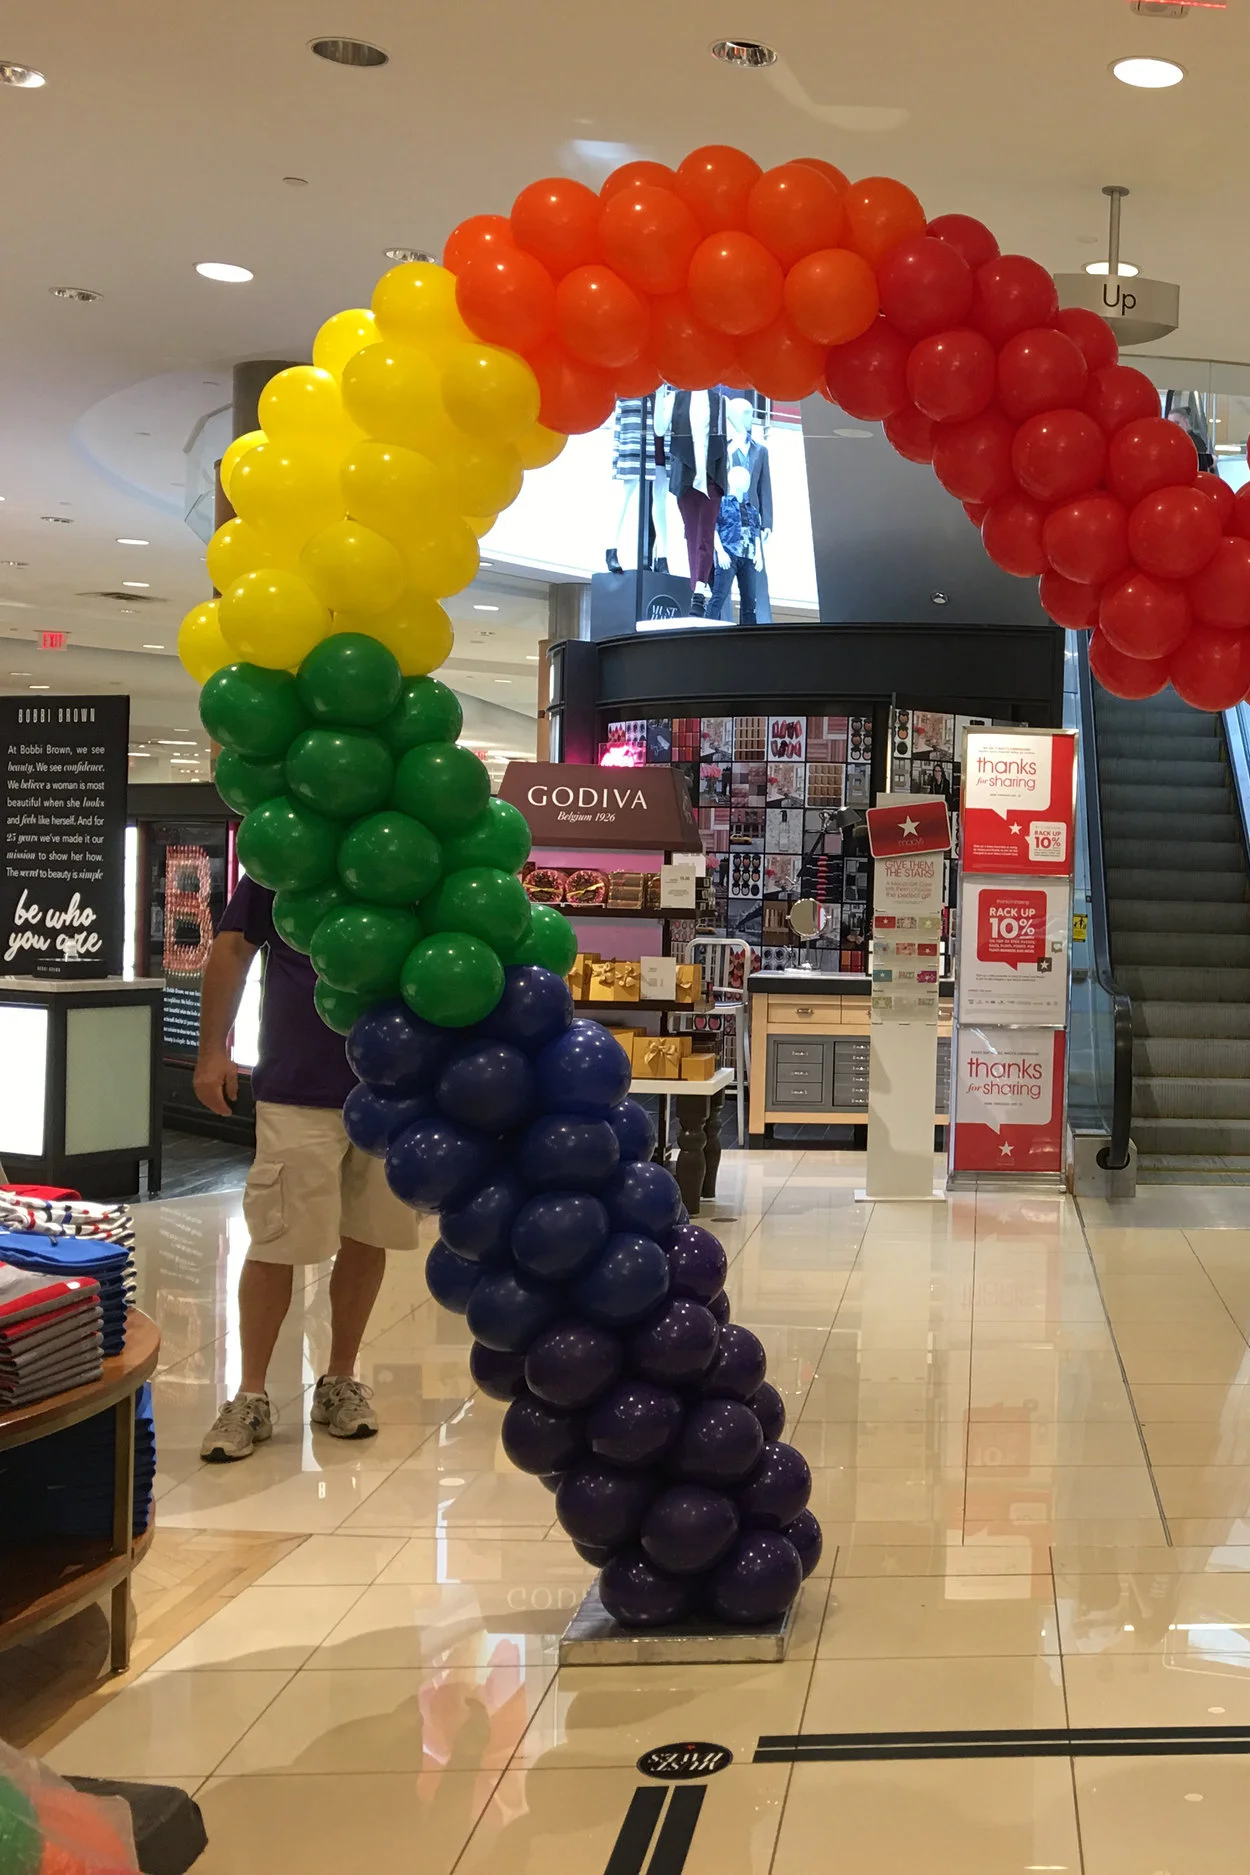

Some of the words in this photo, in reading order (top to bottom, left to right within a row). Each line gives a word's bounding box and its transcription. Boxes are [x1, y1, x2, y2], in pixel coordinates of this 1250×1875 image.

[1103, 284, 1137, 316] Up
[18, 708, 51, 723] BOBBI
[58, 708, 95, 723] BROWN
[8, 745, 17, 754] At
[20, 744, 43, 754] Bobbi
[46, 744, 73, 755] Brown,
[36, 762, 48, 772] We
[49, 764, 62, 772] see
[63, 761, 105, 774] confidence.
[976, 757, 1037, 775] thanks
[7, 780, 19, 789] We
[20, 779, 45, 789] believe
[79, 780, 86, 790] is
[86, 781, 105, 790] most
[976, 777, 989, 786] for
[989, 775, 1036, 792] sharing
[7, 796, 41, 807] beautiful
[43, 797, 64, 807] when
[66, 798, 80, 808] she
[83, 797, 105, 807] looks
[527, 785, 648, 810] GODIVA
[6, 815, 20, 825] and
[20, 814, 37, 827] feels
[38, 815, 50, 825] like
[51, 815, 76, 826] herself.
[77, 816, 92, 826] And
[93, 816, 104, 826] for
[557, 811, 593, 823] Belgium
[595, 812, 616, 823] 1926
[6, 833, 16, 842] 25
[18, 834, 38, 844] years
[40, 833, 60, 843] we've
[62, 834, 83, 844] made
[84, 834, 90, 844] it
[91, 836, 104, 844] our
[1034, 836, 1061, 849] 10%
[6, 850, 36, 859] mission
[38, 852, 47, 860] to
[48, 851, 68, 861] show
[70, 851, 83, 861] her
[85, 851, 104, 862] how.
[885, 860, 908, 869] GIVE
[909, 861, 934, 870] THEM
[6, 867, 19, 877] The
[39, 869, 47, 878] to
[47, 868, 71, 881] beauty
[72, 870, 78, 879] is
[78, 869, 104, 882] simple
[885, 868, 902, 878] THE
[14, 888, 43, 926] be
[45, 892, 97, 930] who
[989, 907, 1018, 917] RACK
[1020, 908, 1036, 917] UP
[989, 918, 1036, 939] 10%
[3, 930, 51, 962] you
[967, 1057, 1042, 1080] thanks
[966, 1083, 982, 1094] for
[983, 1081, 1041, 1100] sharing
